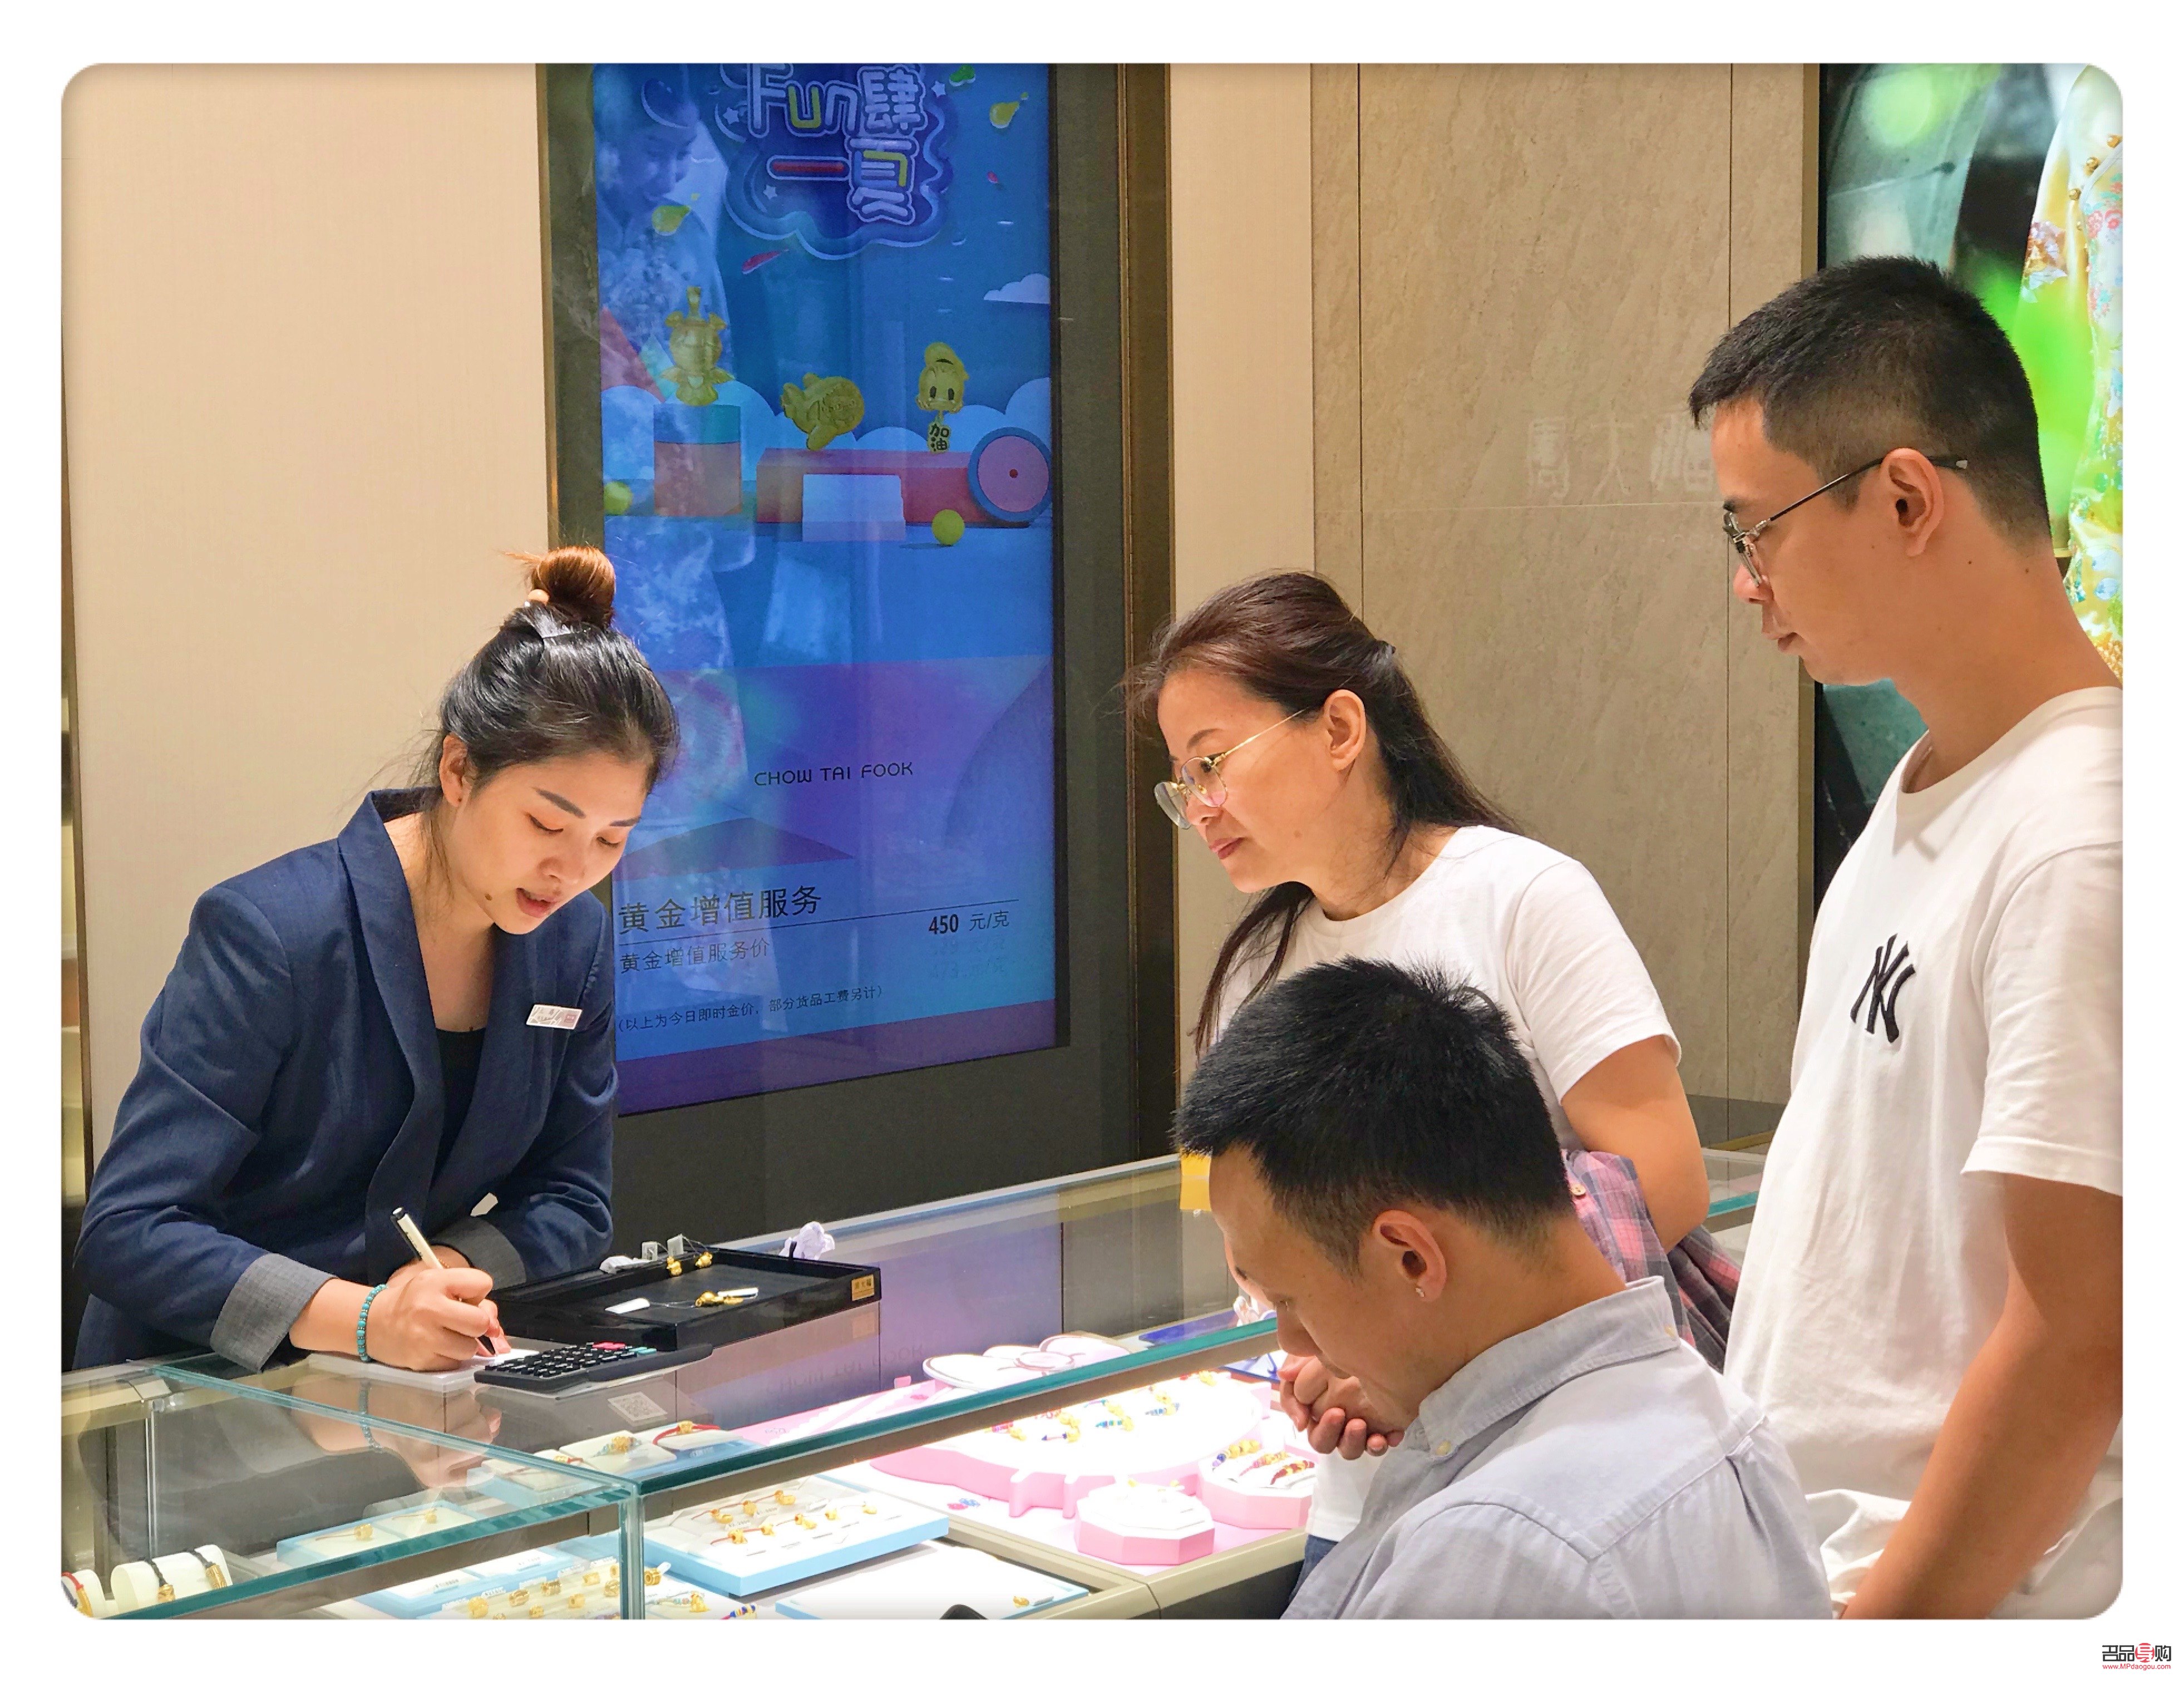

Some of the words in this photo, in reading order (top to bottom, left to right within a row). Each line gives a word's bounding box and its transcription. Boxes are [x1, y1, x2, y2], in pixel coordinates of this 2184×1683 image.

[929, 424, 949, 452] 加油
[755, 769, 812, 785] CHOW
[820, 766, 850, 781] TAI
[861, 762, 913, 778] FOOK
[618, 885, 821, 935] 黄金增值服务
[928, 913, 959, 934] 450
[969, 910, 1009, 931] 元/克
[620, 938, 770, 974] 黄金增值服务价
[1850, 933, 1915, 1043] NY
